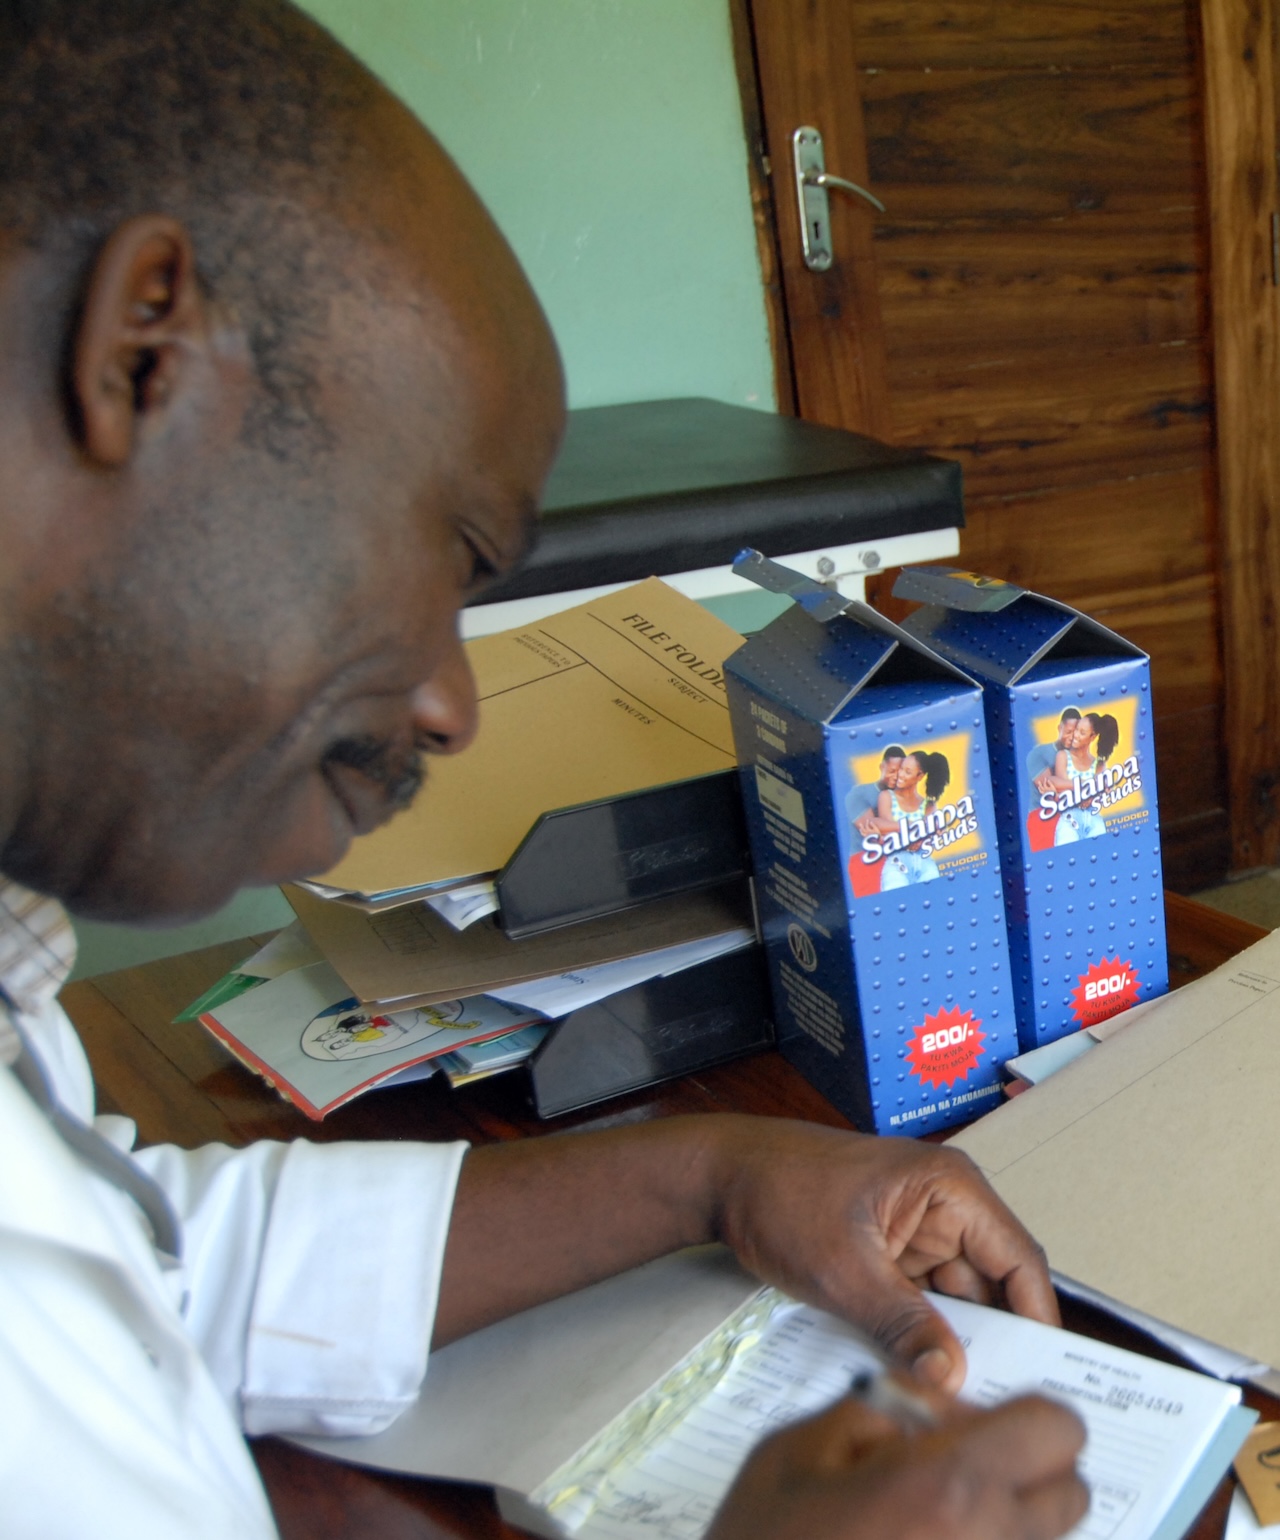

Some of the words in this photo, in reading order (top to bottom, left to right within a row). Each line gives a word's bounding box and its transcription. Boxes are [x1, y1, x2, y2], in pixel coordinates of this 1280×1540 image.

[622, 613, 671, 645] FILE
[664, 643, 728, 693] FOLDE
[667, 677, 708, 704] SUBJECT
[611, 697, 656, 725] MINUTES
[1039, 756, 1139, 820] Salama
[1091, 775, 1142, 815] Studs
[861, 795, 975, 865] Salama
[1105, 810, 1149, 827] STUDDED
[921, 815, 979, 859] Studs
[938, 852, 988, 871] STUDDED
[1085, 972, 1131, 1001] 200/-
[1091, 1001, 1102, 1009] TU
[1102, 995, 1121, 1007] KWA
[1109, 998, 1131, 1015] MOJA
[921, 1022, 975, 1054] 200/-
[920, 1062, 949, 1073] PAKITI
[951, 1050, 975, 1069] MOJA
[930, 1053, 941, 1061] TU
[943, 1045, 964, 1060] KWA
[901, 1103, 937, 1123] SALAMA
[938, 1099, 951, 1111] NA
[1099, 1362, 1111, 1371] OF
